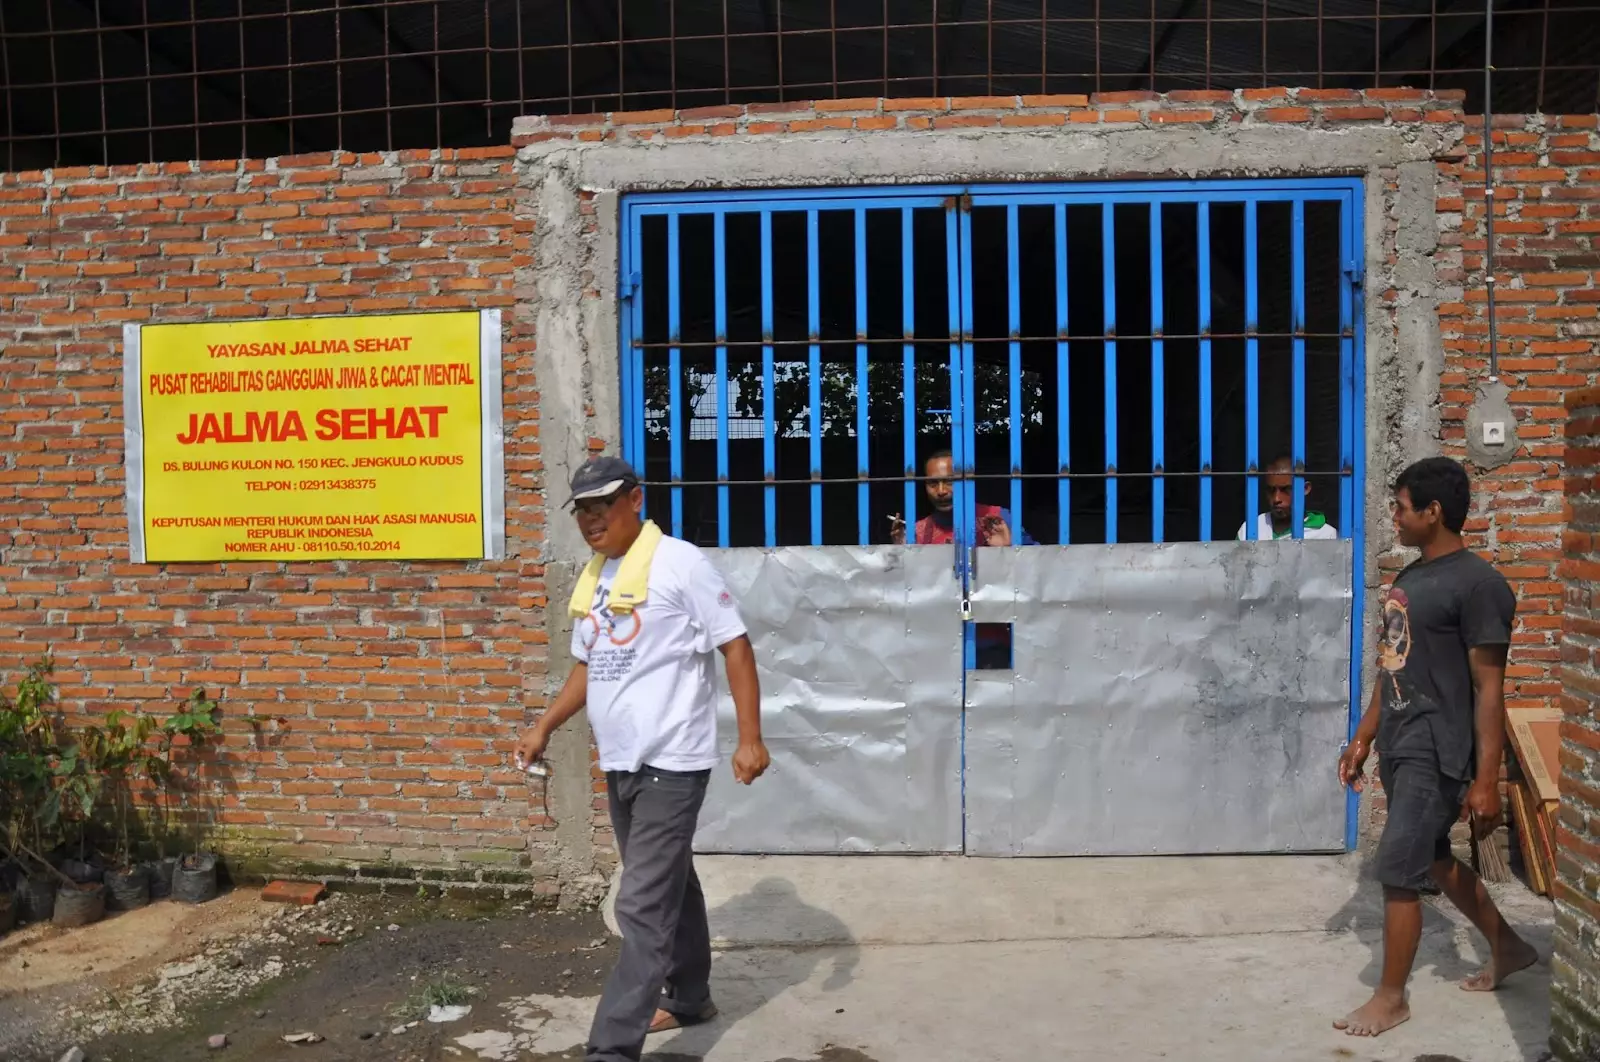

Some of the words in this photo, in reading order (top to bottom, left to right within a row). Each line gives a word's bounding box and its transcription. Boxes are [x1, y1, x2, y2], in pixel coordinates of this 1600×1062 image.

[207, 343, 287, 358] YAYASAN
[290, 340, 350, 356] JALMA
[353, 336, 413, 353] SEHAT
[149, 373, 188, 396] PUSAT
[190, 370, 264, 394] REHABILITAS
[266, 367, 334, 392] GANGGUAN
[336, 366, 367, 389] JIWA
[369, 366, 379, 388] &
[381, 364, 421, 388] CACAT
[423, 362, 475, 386] MENTAL
[176, 410, 308, 445] JALMA
[314, 405, 449, 441] SEHAT
[163, 461, 181, 472] DS.
[183, 460, 229, 471] BULUNG
[231, 459, 273, 471] KULON
[275, 459, 295, 470] NO.
[298, 458, 318, 469] 150
[320, 458, 349, 469] KEC.
[351, 456, 417, 468] JENGKULO
[419, 455, 464, 467] KUDUS
[245, 481, 292, 492] TELPON
[299, 479, 377, 491] 02913438375
[152, 517, 222, 528] KEPUTUSAN
[224, 516, 276, 527] MENTERI
[278, 516, 324, 527] HUKUM
[325, 515, 351, 526] DAN
[353, 515, 381, 526] HAK
[382, 514, 417, 525] ASASI
[419, 513, 477, 525] MANUSIA
[247, 529, 306, 540] REPUBLIK
[308, 528, 373, 539] INDONESIA
[224, 543, 268, 553] NOMER
[269, 543, 296, 553] AHU
[302, 541, 401, 553] 08110.50.10.2014
